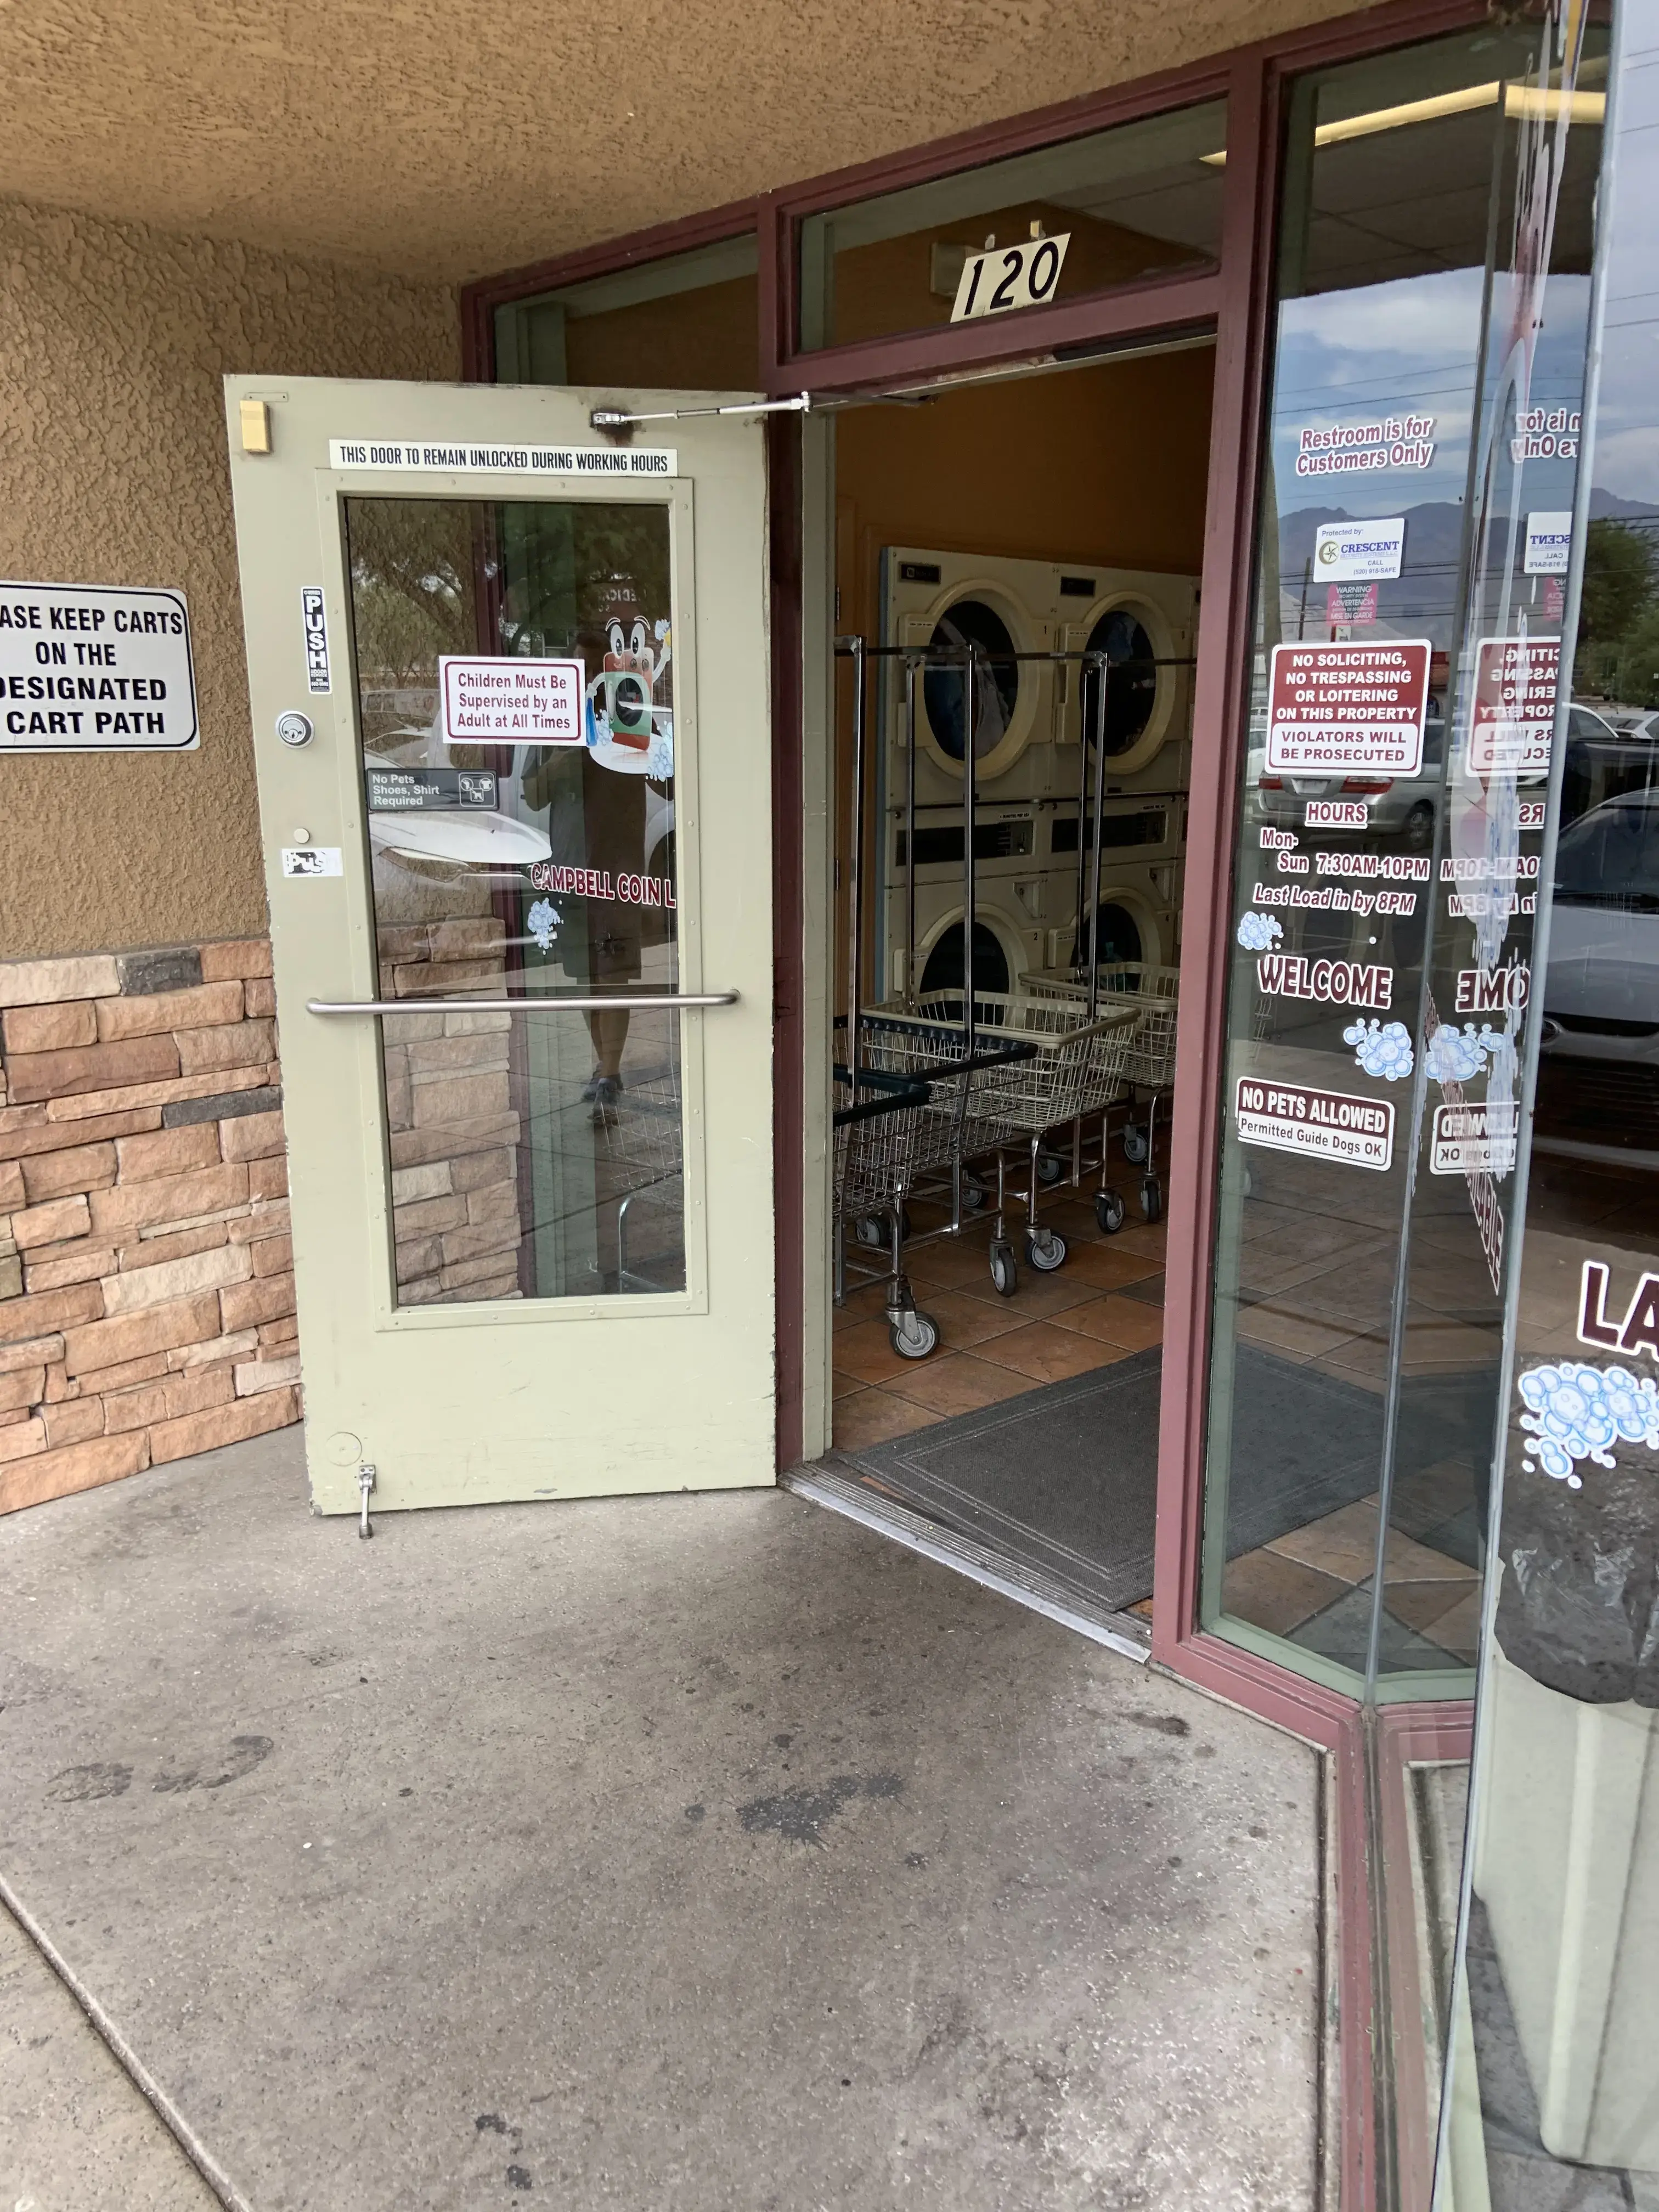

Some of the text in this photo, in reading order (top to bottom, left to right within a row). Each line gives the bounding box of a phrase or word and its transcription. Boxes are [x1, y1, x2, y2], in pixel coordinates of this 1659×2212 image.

[964, 241, 1059, 315] 120
[1302, 417, 1431, 449] Restroom is for
[340, 446, 667, 472] THIS DOOR TO REMAIN UNLOCKED DURING WORKING HOURS
[1298, 442, 1431, 473] Customers Only
[1341, 541, 1400, 554] CRESCENT
[50, 607, 105, 631] KEEP
[114, 610, 183, 635] CARTS
[306, 595, 328, 668] PUSH
[36, 641, 117, 666] ON THE
[1293, 652, 1407, 667] NO SOLICITING,
[458, 673, 566, 689] Children Must Be
[1286, 670, 1412, 685] NO TRESPASSING
[459, 693, 567, 712] Supervised by an
[1295, 689, 1398, 702] OR LOITERING
[7, 711, 165, 734] CART PATH
[458, 713, 570, 729] Adult at All Times
[1277, 707, 1417, 720] ON THIS PROPERTY
[1282, 731, 1406, 743] VIOLATORS WILL
[1281, 748, 1404, 761] BE PROSECUTED
[373, 774, 415, 784] No Pets
[373, 785, 439, 795] Shoes, Shirt
[374, 796, 423, 807] Required
[1308, 803, 1365, 822] HOURS
[1261, 830, 1297, 848] Mon-
[1279, 853, 1429, 878] Sun 7:30AM-10PM
[531, 863, 615, 900] CAMPBELL
[618, 873, 661, 906] COIN
[1255, 885, 1415, 913] Last Load in by 8PM
[1258, 955, 1392, 1009] WELCOME
[1242, 1086, 1385, 1133] NO PETS ALLOWED
[1241, 1118, 1382, 1158] Permitted Guide Dogs OK
